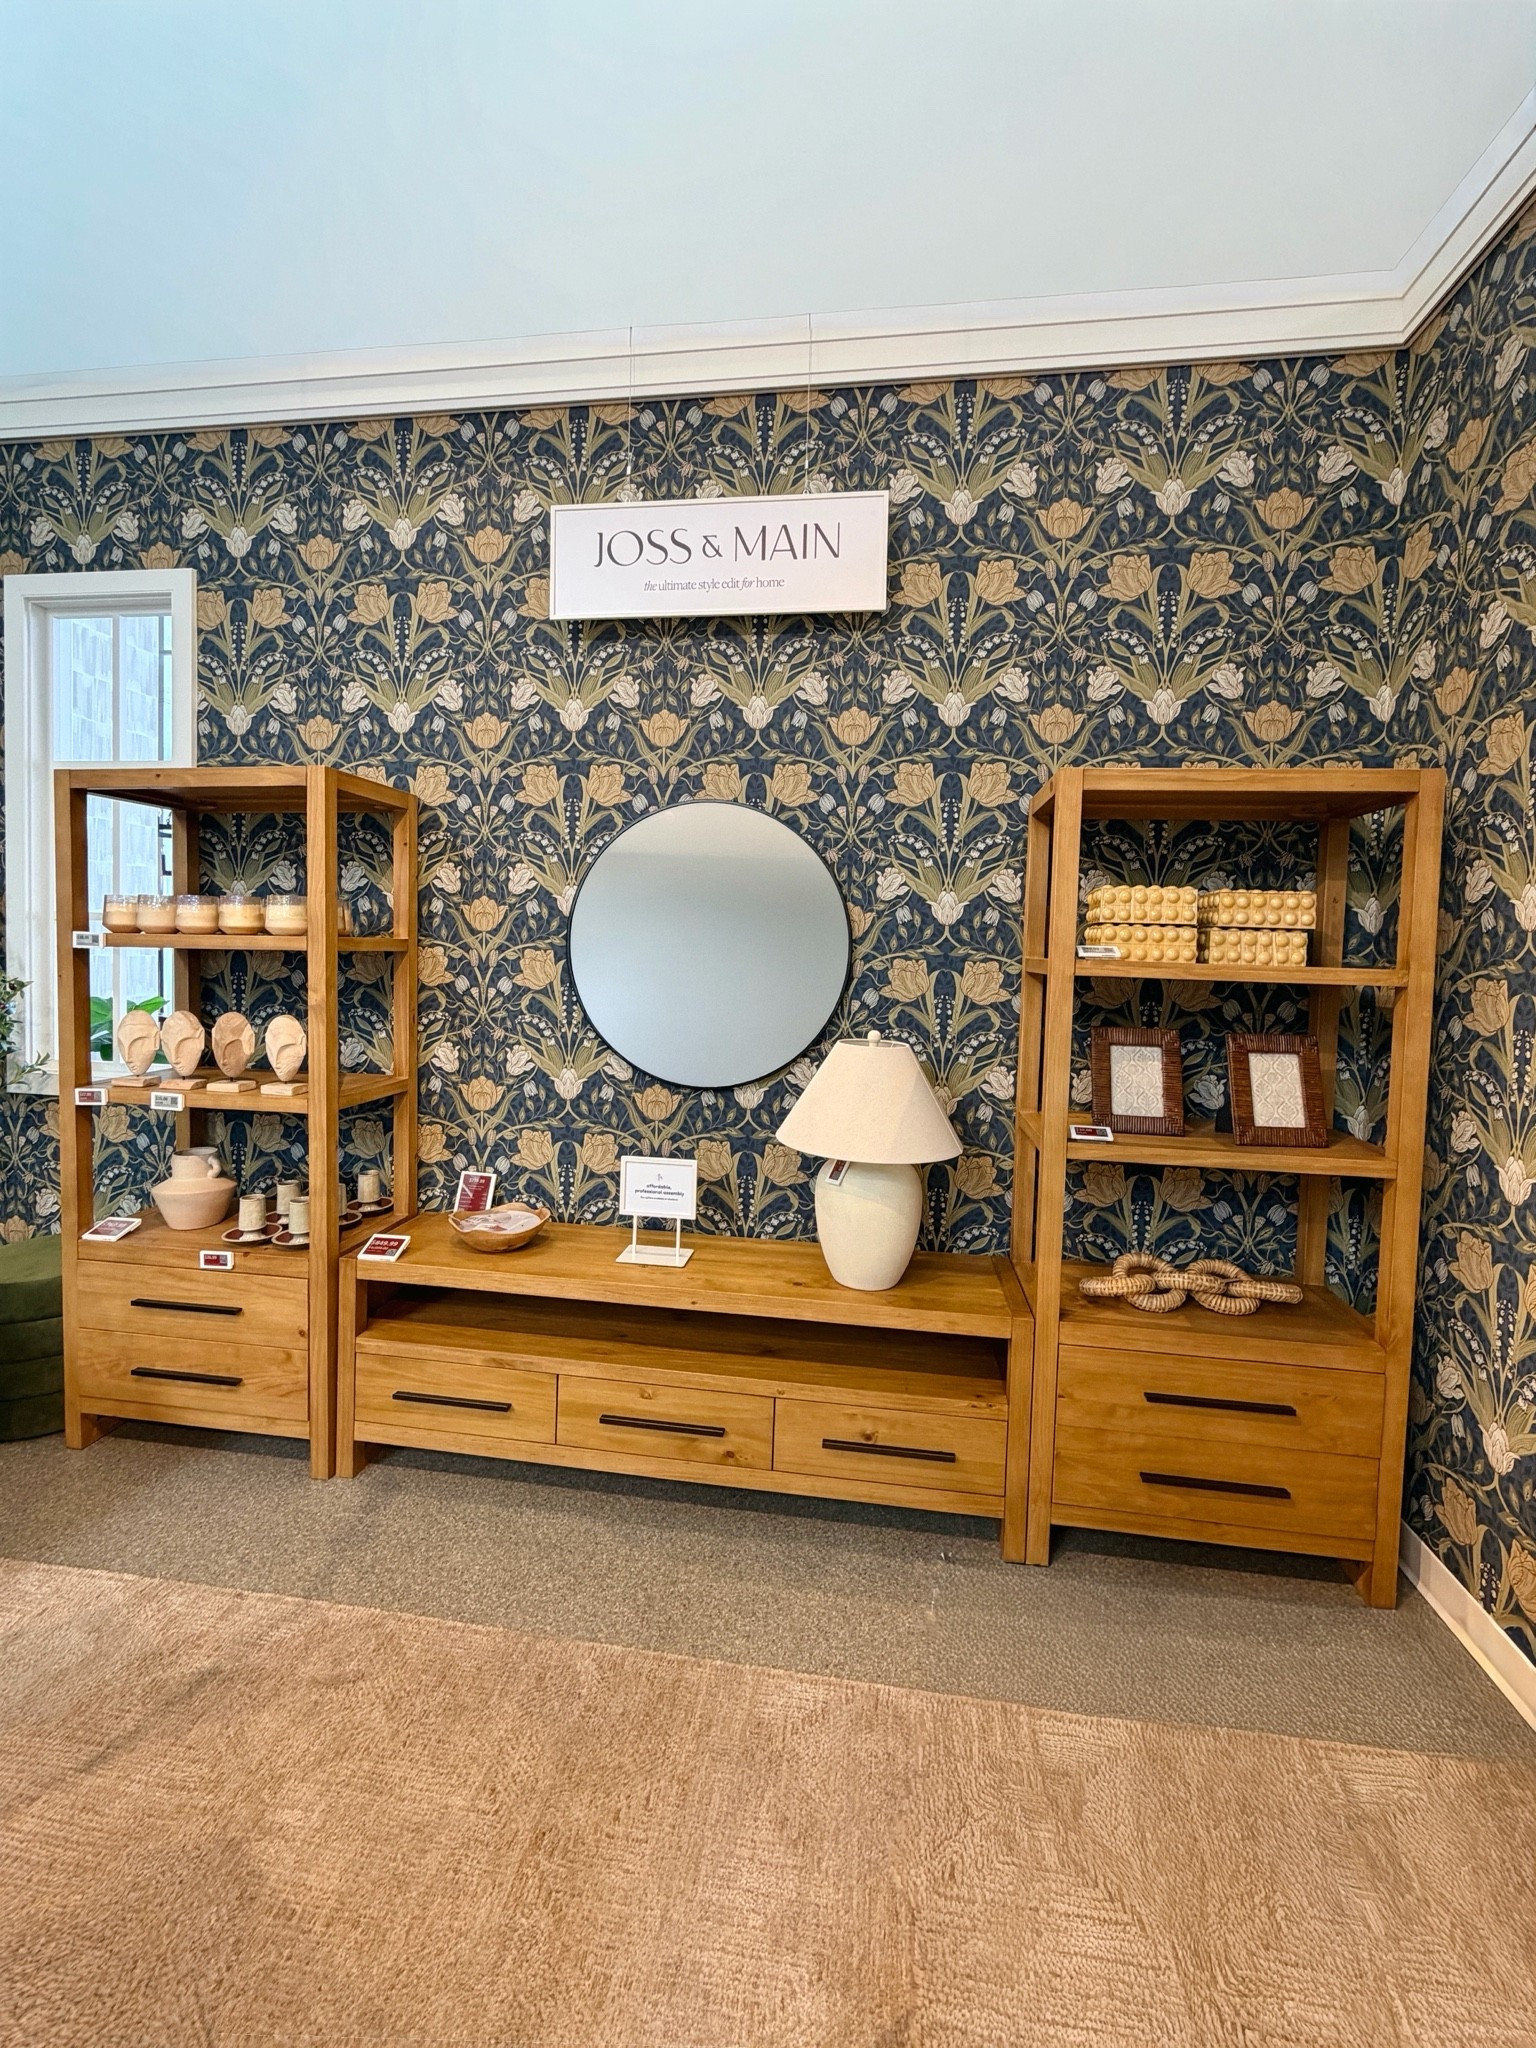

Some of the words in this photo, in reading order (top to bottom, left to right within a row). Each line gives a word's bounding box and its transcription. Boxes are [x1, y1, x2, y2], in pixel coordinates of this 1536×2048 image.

[594, 528, 692, 568] JOSS
[702, 534, 723, 558] &
[734, 522, 841, 562] MAIN
[644, 580, 658, 591] the
[658, 579, 697, 591] ultimate
[697, 578, 720, 593] style
[721, 577, 740, 589] edit
[739, 576, 755, 591] for
[756, 576, 785, 588] home
